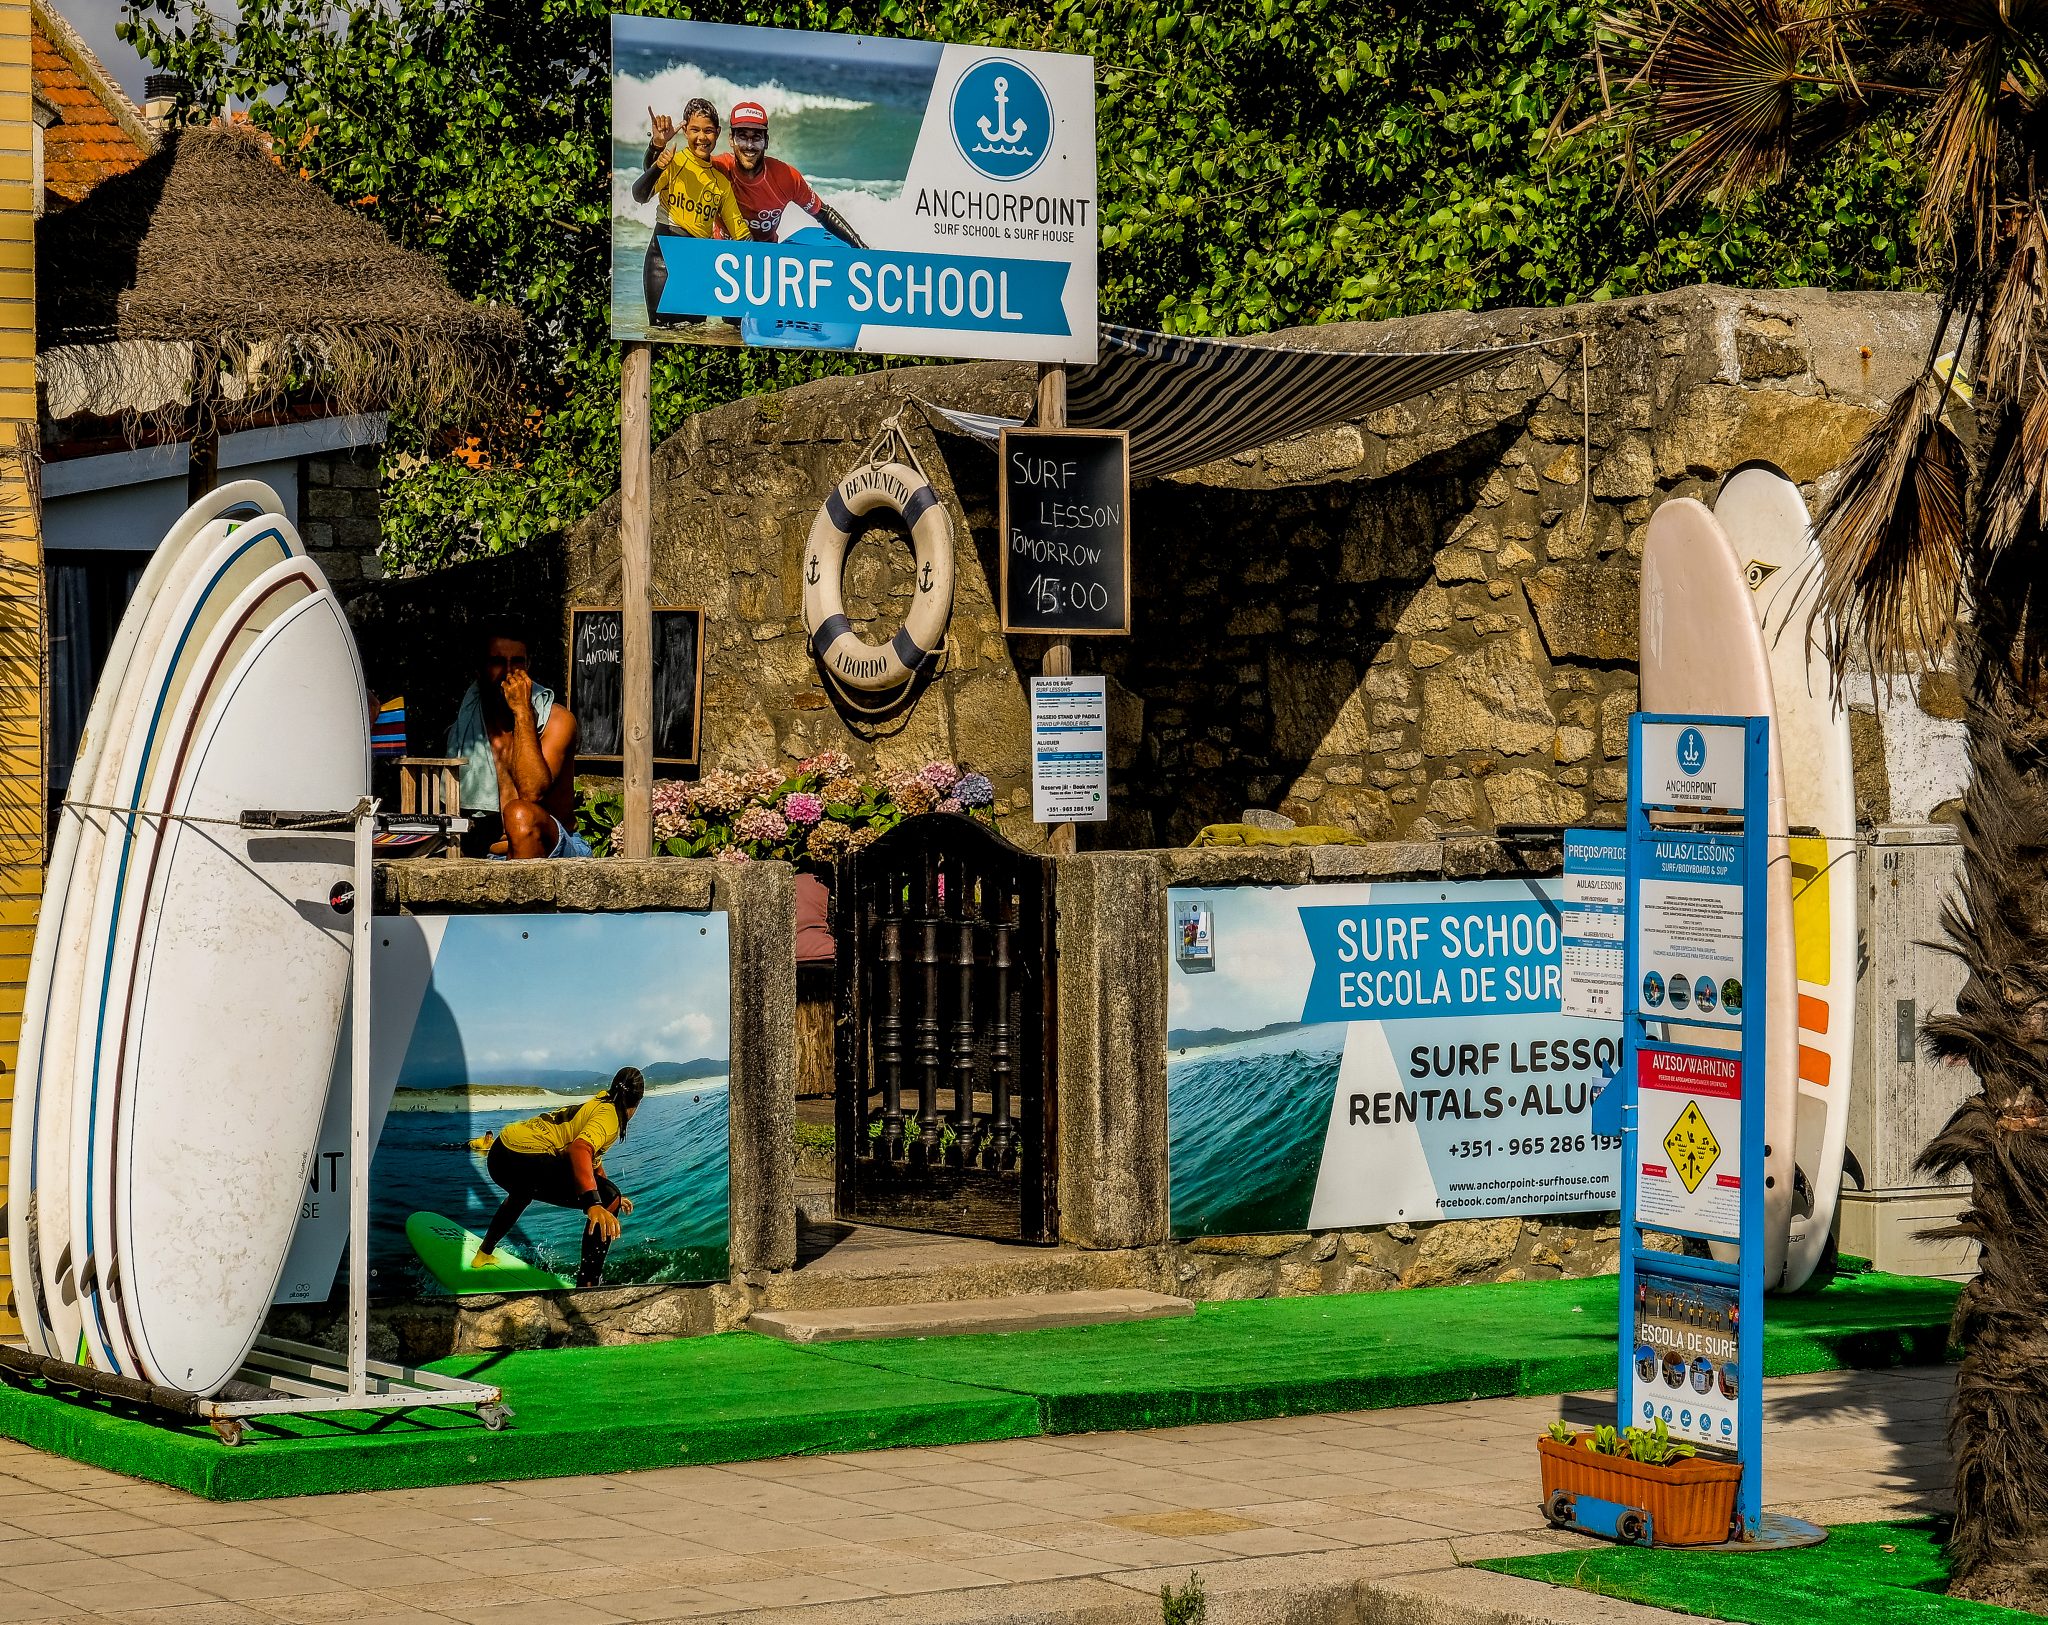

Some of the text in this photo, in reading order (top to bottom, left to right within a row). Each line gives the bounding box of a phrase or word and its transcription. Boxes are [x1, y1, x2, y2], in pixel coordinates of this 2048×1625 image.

[915, 188, 1091, 227] ANCHORPOINT
[934, 223, 1075, 243] SURF SCHOOL & SURF HOUSE
[714, 252, 1023, 321] SURF SCHOOL
[1012, 452, 1078, 489] SURF
[845, 472, 909, 505] BENVENUTO
[1040, 501, 1121, 529] LESSON
[1011, 527, 1102, 566] TOMORROW
[1027, 573, 1108, 614] 15:00
[583, 621, 617, 649] 15:00
[833, 652, 887, 678] A BORDO
[1666, 780, 1717, 794] ANCHORPOINT
[1568, 845, 1626, 862] PREÇOS/PRICE
[1655, 843, 1735, 862] AULAS/LESSONS
[1662, 862, 1710, 874] SURF/BODYBOARD
[1716, 866, 1728, 875] SUP
[1576, 880, 1622, 890] AULAS/LESSONS
[1338, 917, 1430, 962] SURF
[1440, 913, 1557, 959] SCHOO
[1340, 964, 1561, 1008] ESCOLA DE SUR
[1410, 1037, 1623, 1078] SURF LESSO
[1652, 1054, 1735, 1078] AVISO/WARNING
[1449, 1140, 1492, 1158] +351
[1509, 1137, 1544, 1156] 965
[1550, 1135, 1585, 1153] 286
[1590, 1136, 1622, 1151] 195
[1449, 1174, 1610, 1192] www.anchorpoint-surfhouse.com
[1436, 1189, 1616, 1208] facebook.com/anchorpointsurfhouse
[1641, 1324, 1736, 1358] ESCOLA DE SURF
